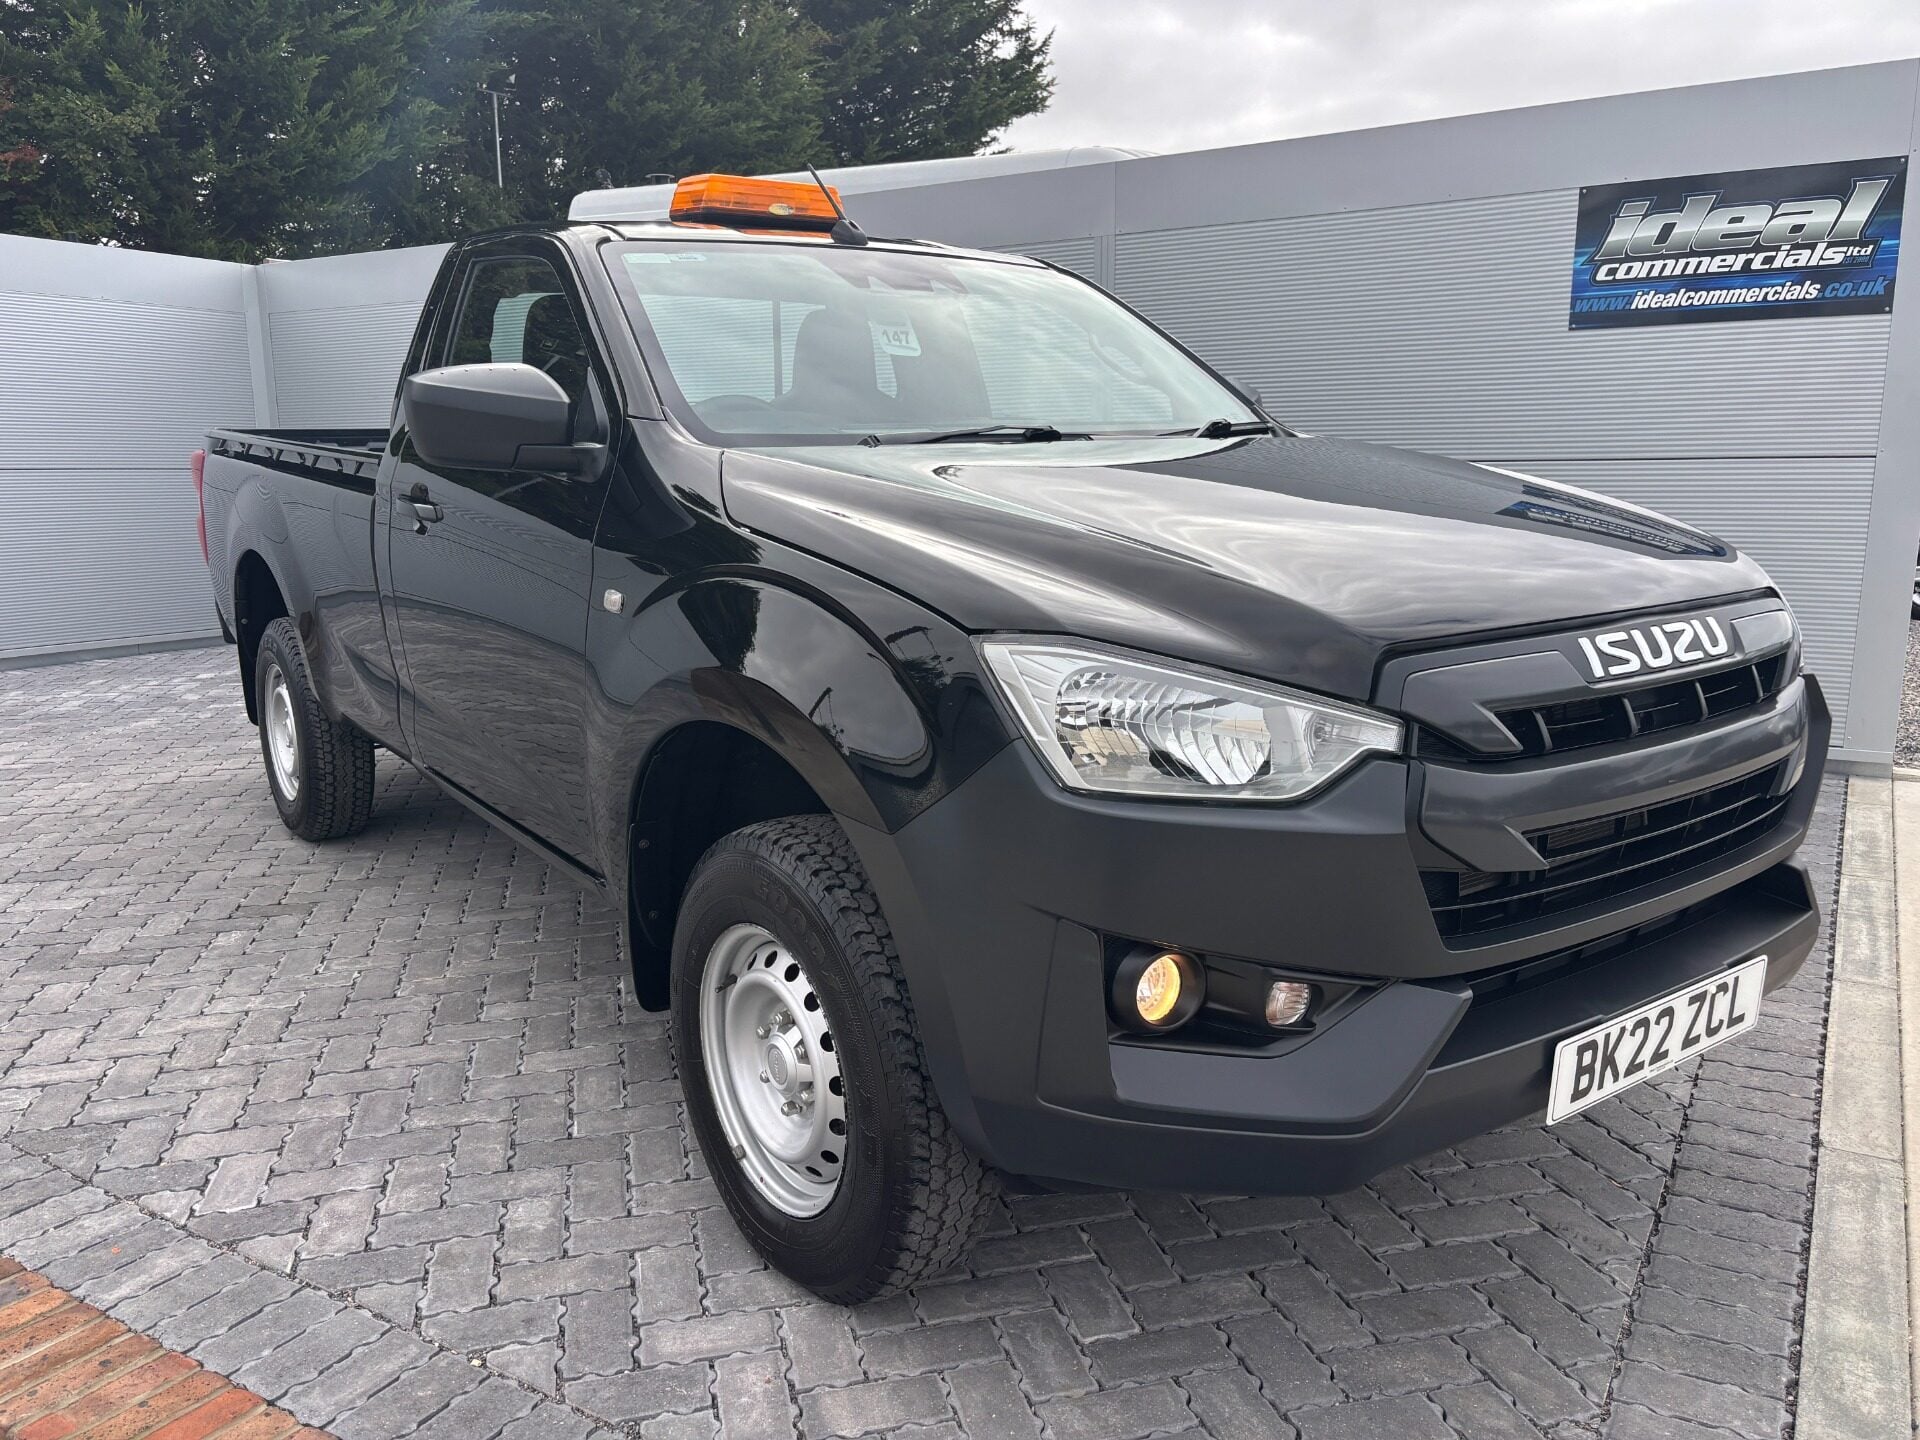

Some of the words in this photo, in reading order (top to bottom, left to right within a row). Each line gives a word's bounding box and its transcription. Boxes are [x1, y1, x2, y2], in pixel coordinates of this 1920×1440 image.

[1594, 179, 1889, 260] ideal
[1595, 242, 1847, 282] commercials
[1846, 244, 1874, 256] ltd
[1574, 276, 1889, 313] www.idealcommercials.co.uk
[881, 329, 910, 345] 147
[1577, 616, 1728, 679] ISUZU
[1570, 1005, 1675, 1104] BK22
[1681, 975, 1746, 1051] ZCL
